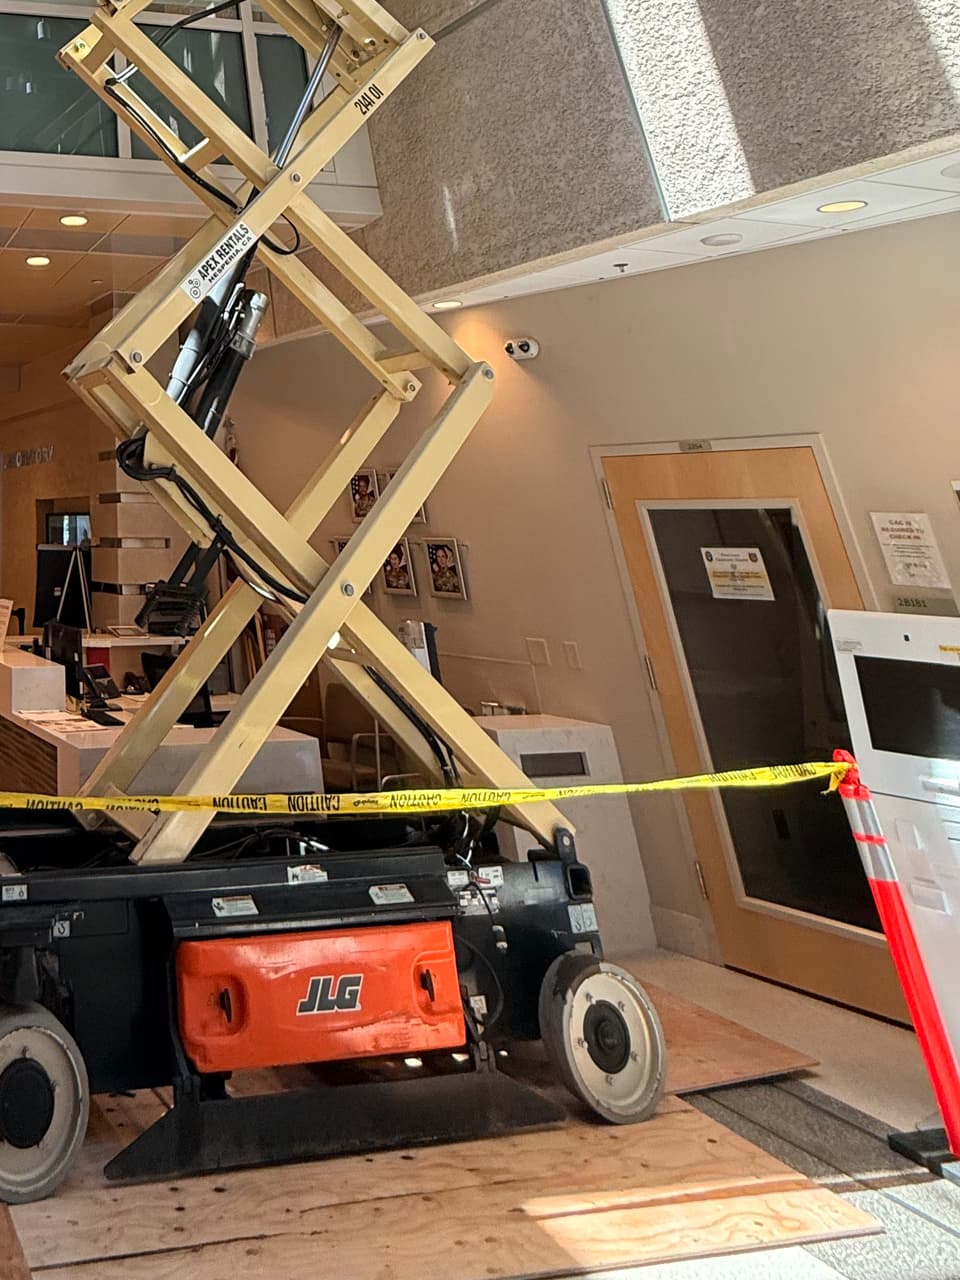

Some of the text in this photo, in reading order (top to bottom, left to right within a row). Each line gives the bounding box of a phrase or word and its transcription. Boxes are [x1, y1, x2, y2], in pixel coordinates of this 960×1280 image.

[241, 236, 252, 247] CA
[197, 223, 249, 281] APEX RENTALS
[288, 795, 340, 812] CAUTION
[389, 793, 442, 808] CAUTION
[296, 974, 364, 1016] JLG
